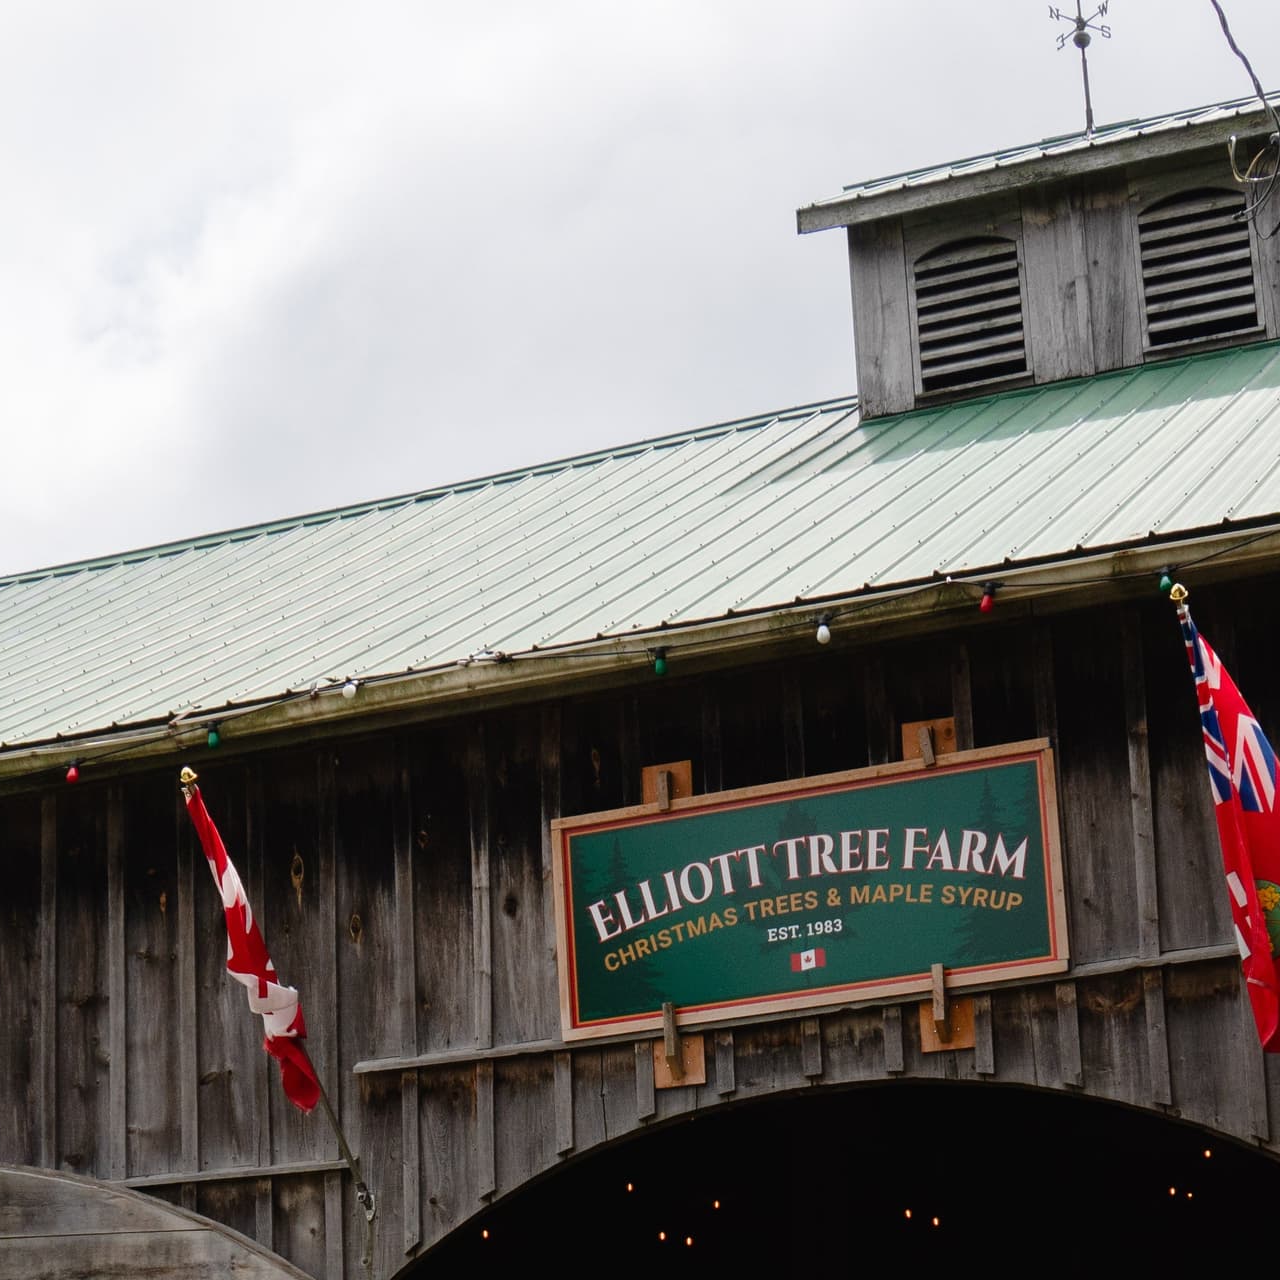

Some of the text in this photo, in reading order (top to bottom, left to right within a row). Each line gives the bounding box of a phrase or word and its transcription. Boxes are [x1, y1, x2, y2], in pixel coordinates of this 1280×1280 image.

[587, 827, 1029, 943] ELLIOTT TREE FARM
[604, 884, 1023, 971] CHRISTMAS TREES & MAPLE SYRUP
[767, 919, 843, 942] EST. 1983
